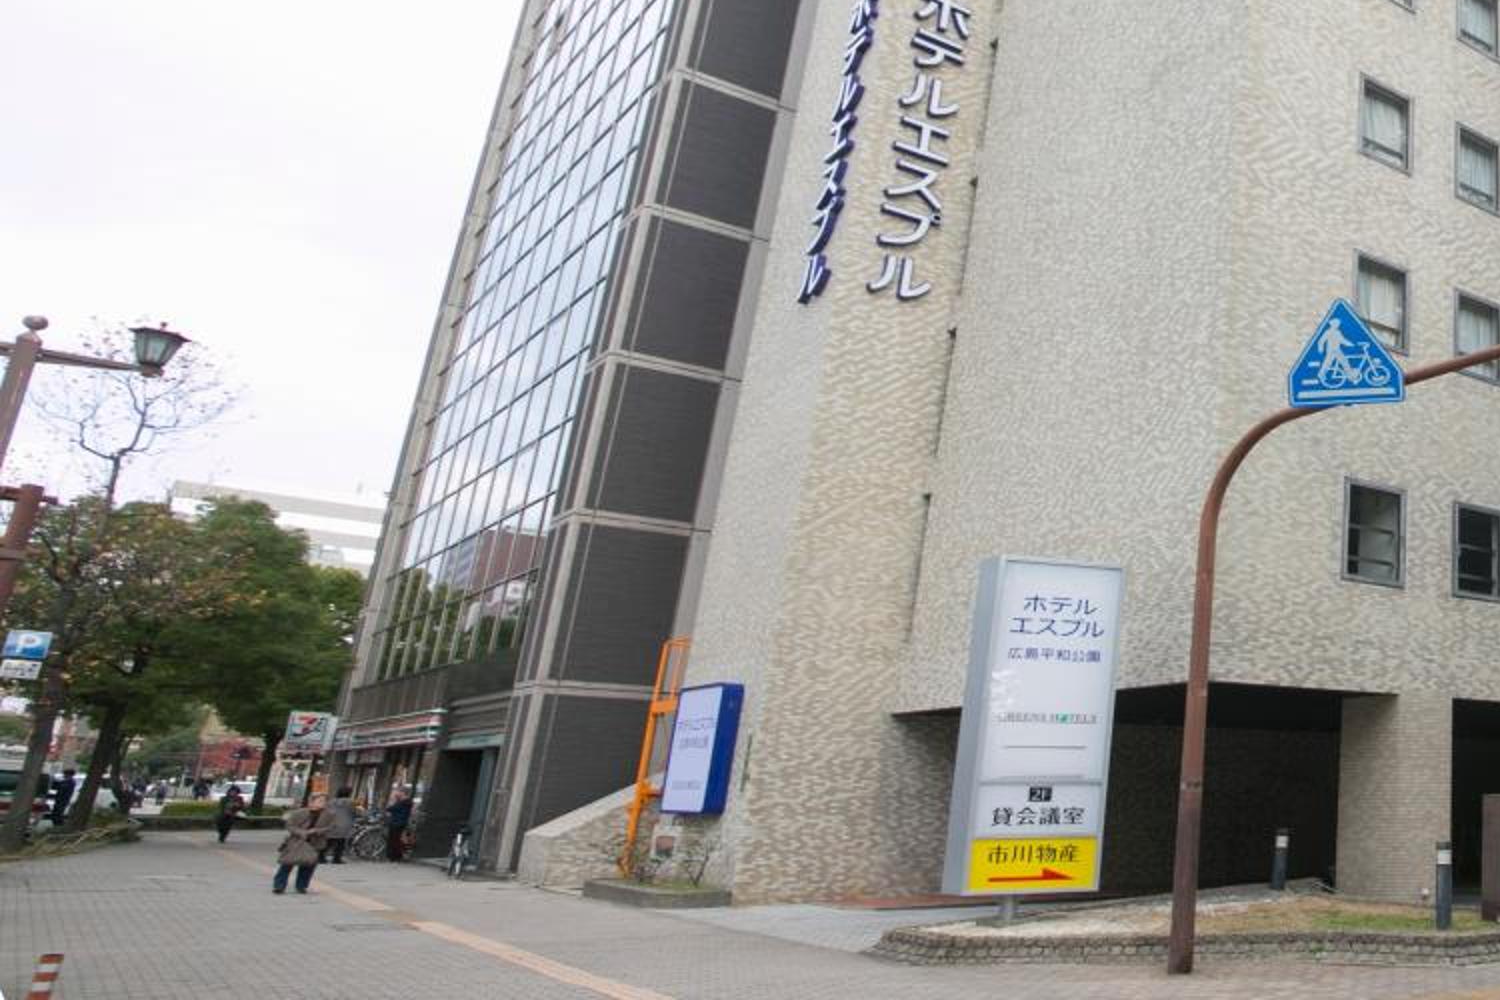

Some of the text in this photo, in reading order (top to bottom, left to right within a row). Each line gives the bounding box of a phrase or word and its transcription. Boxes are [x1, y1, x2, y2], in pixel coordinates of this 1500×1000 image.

[1023, 593, 1098, 615] ホテル
[991, 806, 1086, 827] 貸会議室
